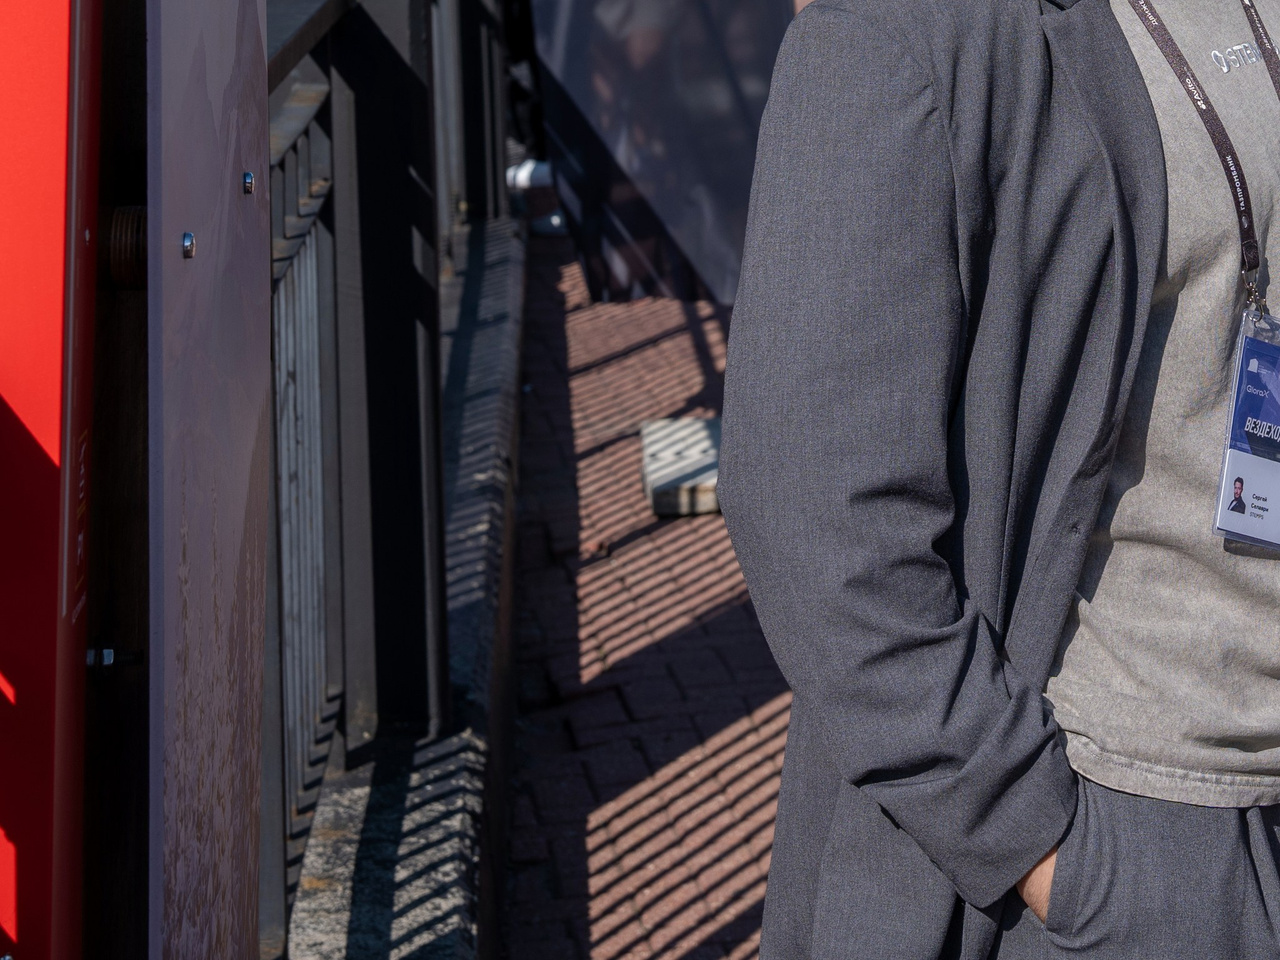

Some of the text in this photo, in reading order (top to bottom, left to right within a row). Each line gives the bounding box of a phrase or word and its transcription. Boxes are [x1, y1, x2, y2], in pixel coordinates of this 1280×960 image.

[1185, 77, 1202, 103] Avito
[1226, 155, 1246, 211] ГАЗПРОМБАНК
[1246, 384, 1270, 398] GloraX
